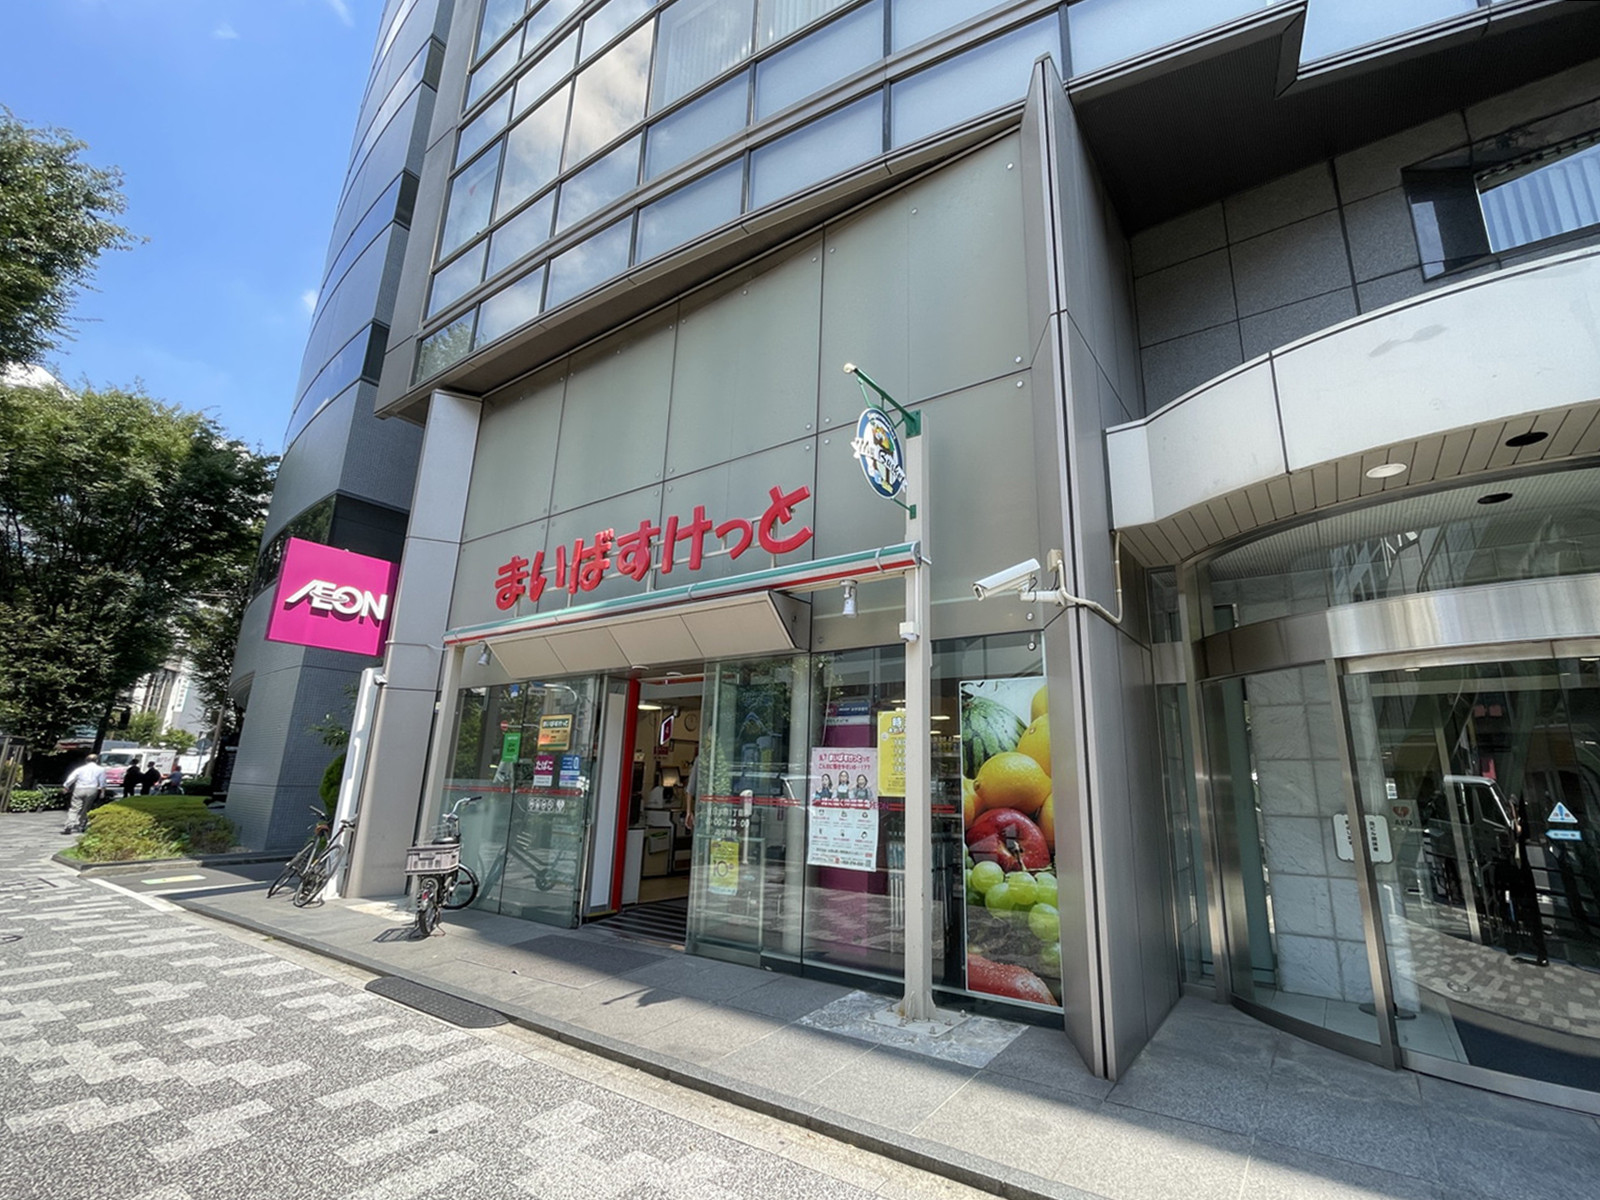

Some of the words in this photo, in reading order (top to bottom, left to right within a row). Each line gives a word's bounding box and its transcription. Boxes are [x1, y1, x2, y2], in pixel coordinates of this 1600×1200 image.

[494, 485, 813, 611] まいばすけっと
